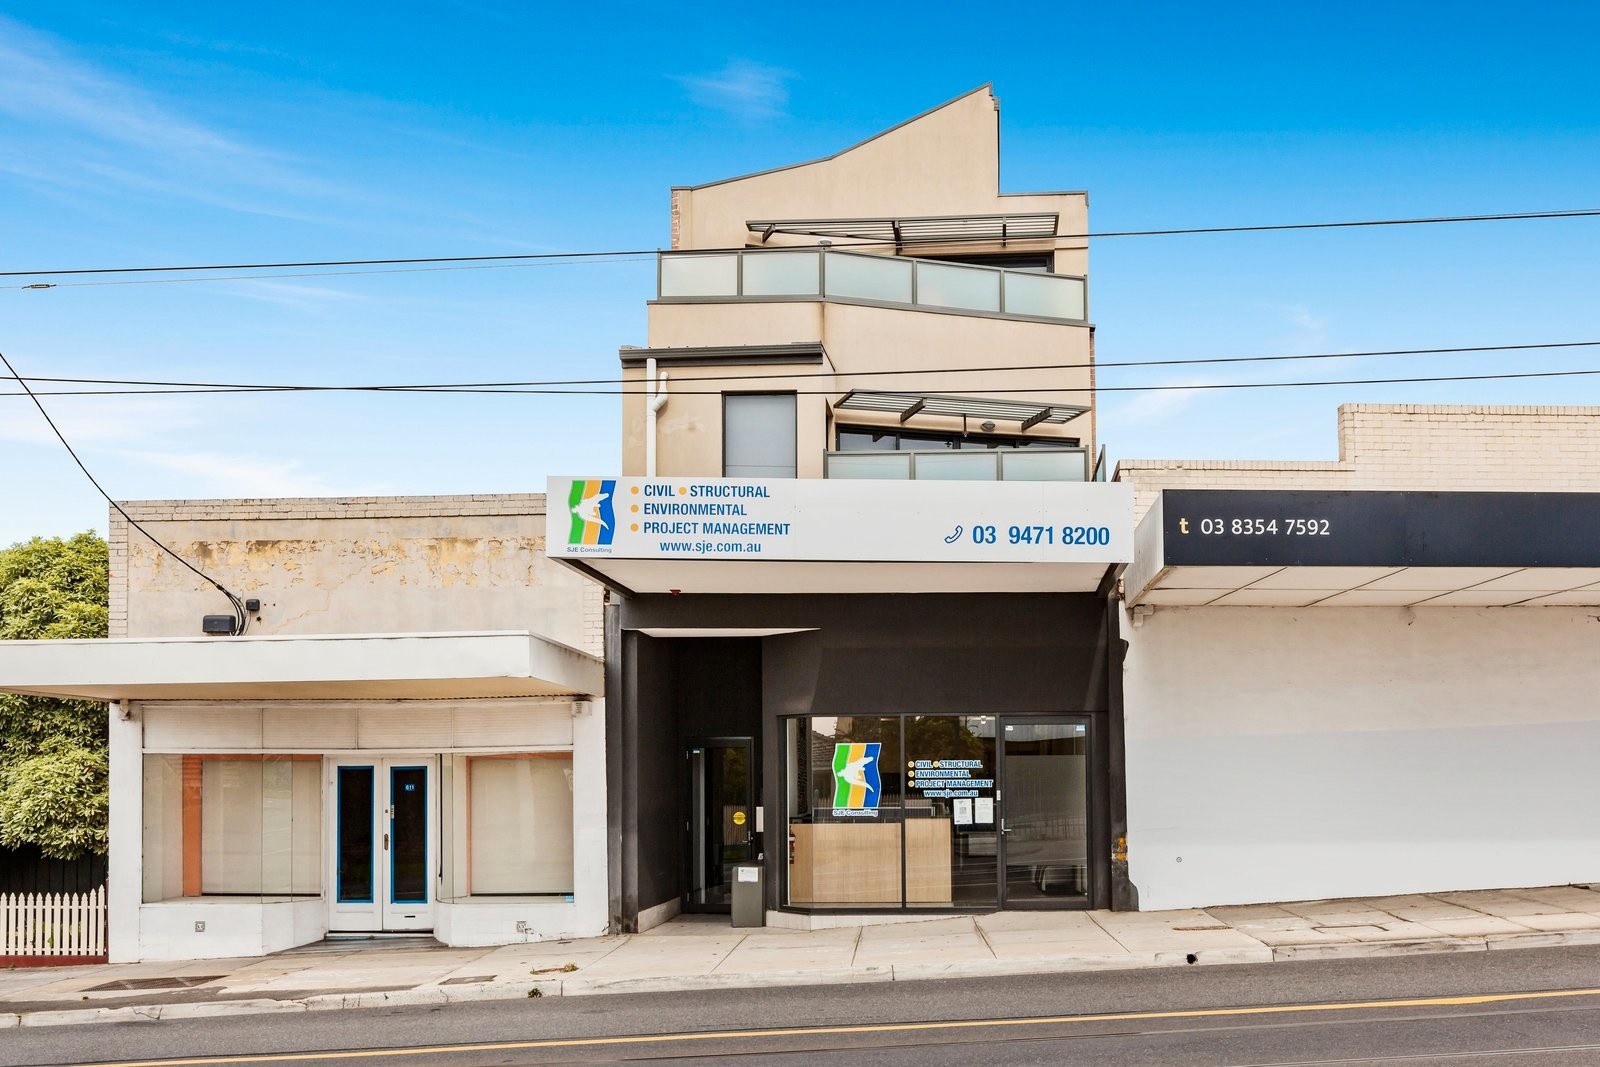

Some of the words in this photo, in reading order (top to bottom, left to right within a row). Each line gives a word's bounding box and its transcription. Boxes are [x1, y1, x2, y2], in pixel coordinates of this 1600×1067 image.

[643, 484, 676, 498] CIVIL
[689, 485, 771, 498] STRUCTURAL
[643, 503, 748, 516] ENVIRONMENTAL
[643, 522, 699, 535] PROJECT
[702, 522, 791, 536] MANAGEMENT
[1179, 517, 1190, 535] t
[1200, 518, 1225, 535] 03
[1231, 518, 1279, 536] 8354
[1284, 518, 1331, 536] 7592
[972, 525, 997, 544] 03
[1008, 525, 1054, 545] 9471
[1062, 526, 1110, 546] 8200
[579, 546, 613, 554] Consulting
[659, 540, 762, 554] www.sje.com.au
[915, 760, 933, 768] CIVIL
[939, 760, 983, 768] STRUCTURAL
[915, 770, 971, 778] ENVIRONMENTAL
[915, 780, 945, 788] PROJECT
[946, 780, 994, 788] MANAGEMENT
[923, 790, 979, 799] www.sje.com.au
